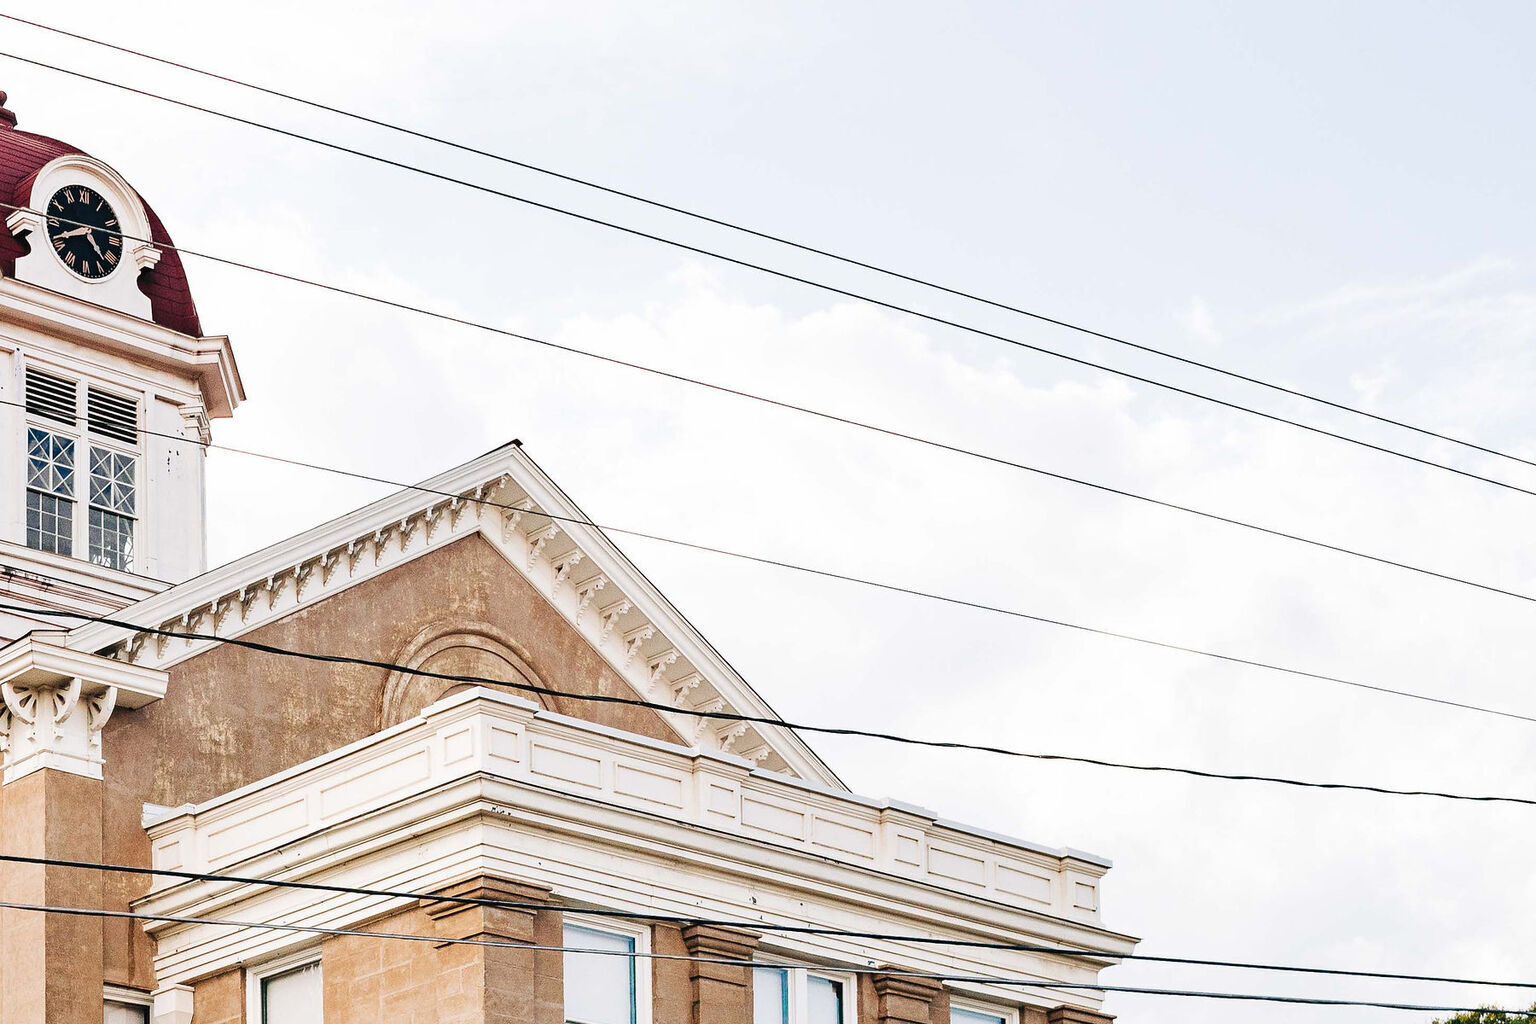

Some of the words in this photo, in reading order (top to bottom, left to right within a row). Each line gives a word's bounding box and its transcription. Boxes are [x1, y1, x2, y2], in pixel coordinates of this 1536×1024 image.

[64, 189, 75, 204] XI
[80, 190, 89, 205] XII
[52, 199, 64, 212] X
[96, 200, 104, 212] I
[105, 219, 118, 227] II
[109, 236, 120, 247] III
